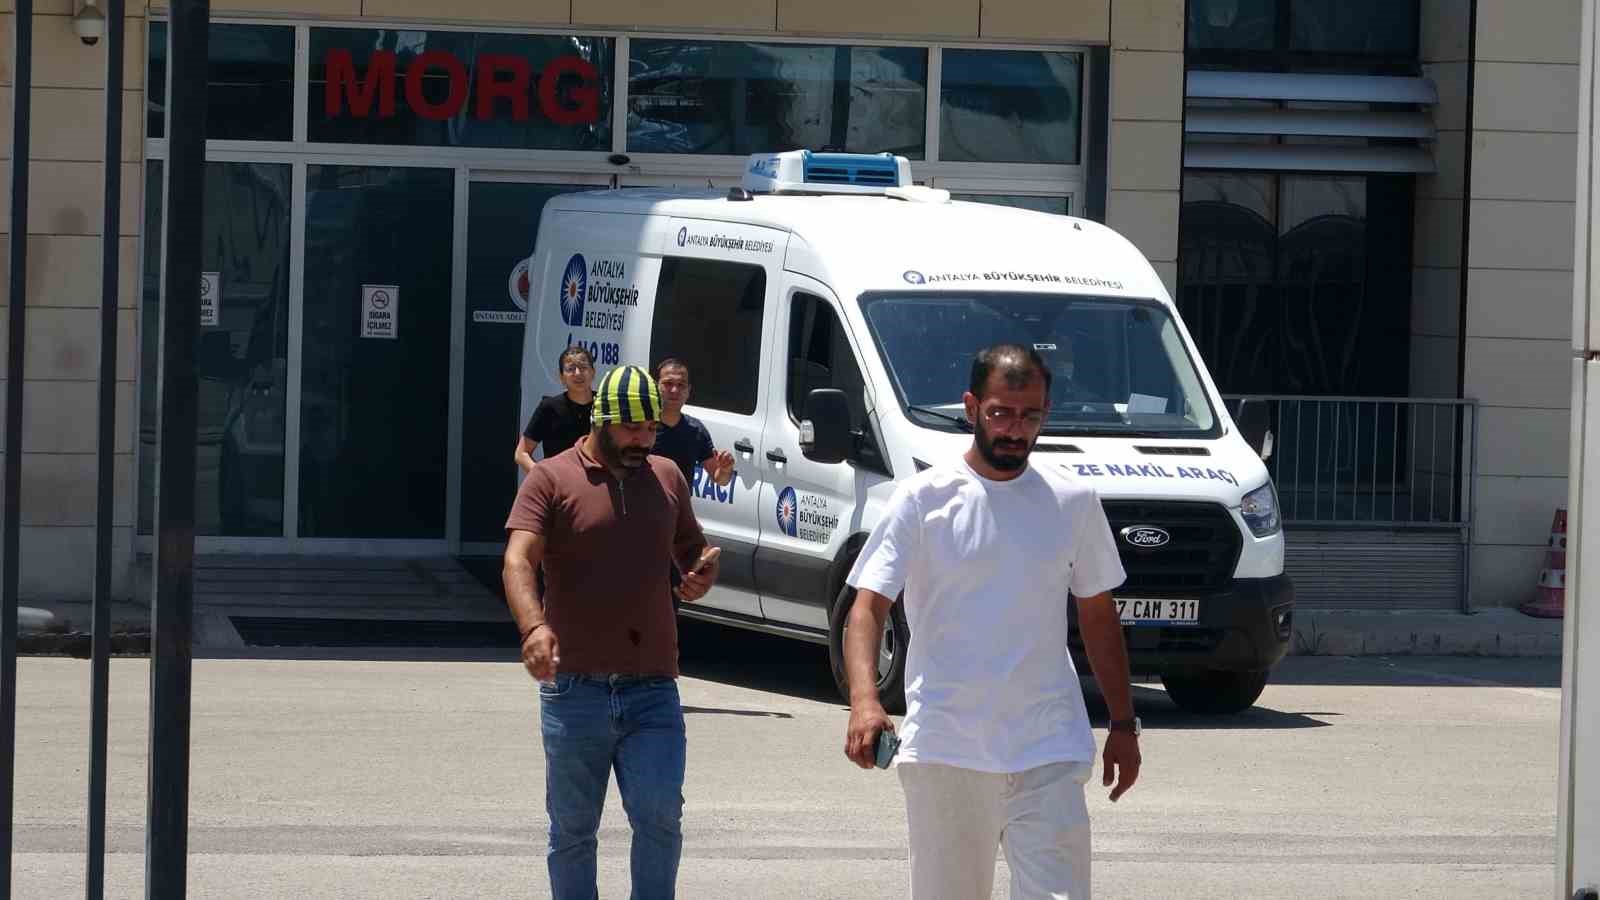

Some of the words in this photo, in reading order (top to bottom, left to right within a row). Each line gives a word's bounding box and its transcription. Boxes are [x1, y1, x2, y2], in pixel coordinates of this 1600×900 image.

[324, 48, 600, 126] MORG
[687, 234, 709, 247] ANTALYA
[709, 234, 744, 251] BÜYÜKŞEHİR
[744, 240, 774, 253] BELEDİYESİ
[590, 260, 625, 279] ANTALYA
[928, 271, 980, 283] ANTALYA
[983, 271, 1062, 284] BÜYÜKŞEHİR
[1064, 276, 1124, 290] BELEDİYESİ
[587, 280, 639, 308] BÜYÜKŞEHİR
[584, 308, 626, 331] BELEDİYESİ
[601, 343, 620, 365] 188
[1061, 464, 1104, 477] ZE
[1105, 463, 1173, 478] NAKİL
[690, 465, 737, 504] RACI
[800, 495, 827, 509] ANTALYA
[1134, 530, 1162, 545] Ford
[1112, 600, 1127, 617] 7
[1133, 601, 1162, 619] CAM
[1168, 602, 1196, 619] 311
